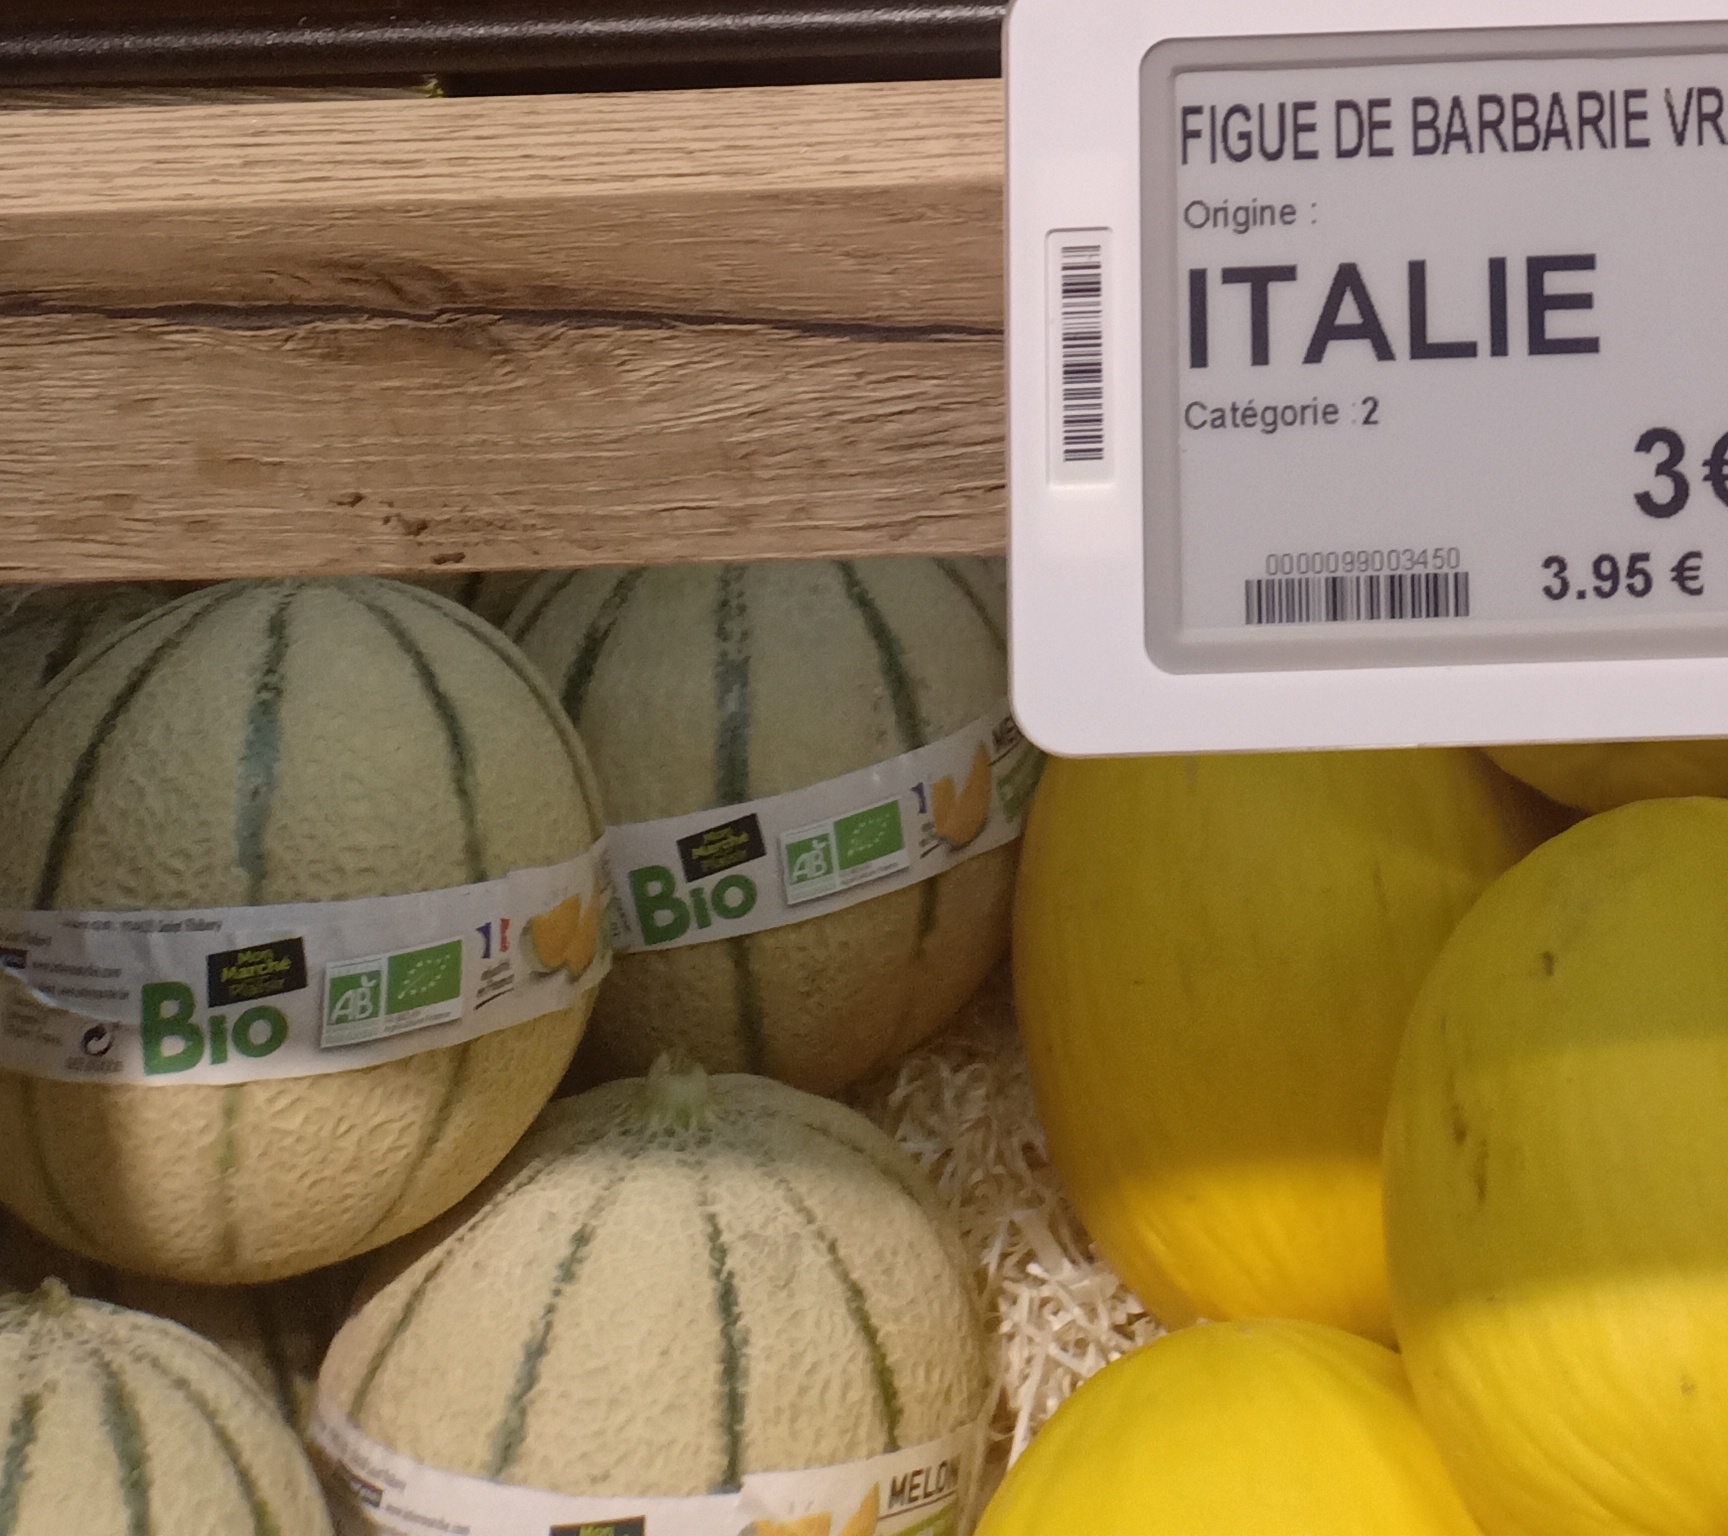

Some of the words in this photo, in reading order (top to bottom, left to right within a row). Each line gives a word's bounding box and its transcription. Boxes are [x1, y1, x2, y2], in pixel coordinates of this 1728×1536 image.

[1181, 100, 1319, 165] FIGUE
[1334, 97, 1394, 159] DE
[1412, 88, 1651, 156] BARBARIE
[1184, 197, 1297, 235] Origine
[1189, 253, 1600, 369] ITALIE
[1184, 396, 1340, 435] Catégorie
[1265, 546, 1461, 576] 0000099003450
[1542, 552, 1653, 601] 3.95
[1670, 550, 1704, 597] €
[330, 980, 374, 1023] AB
